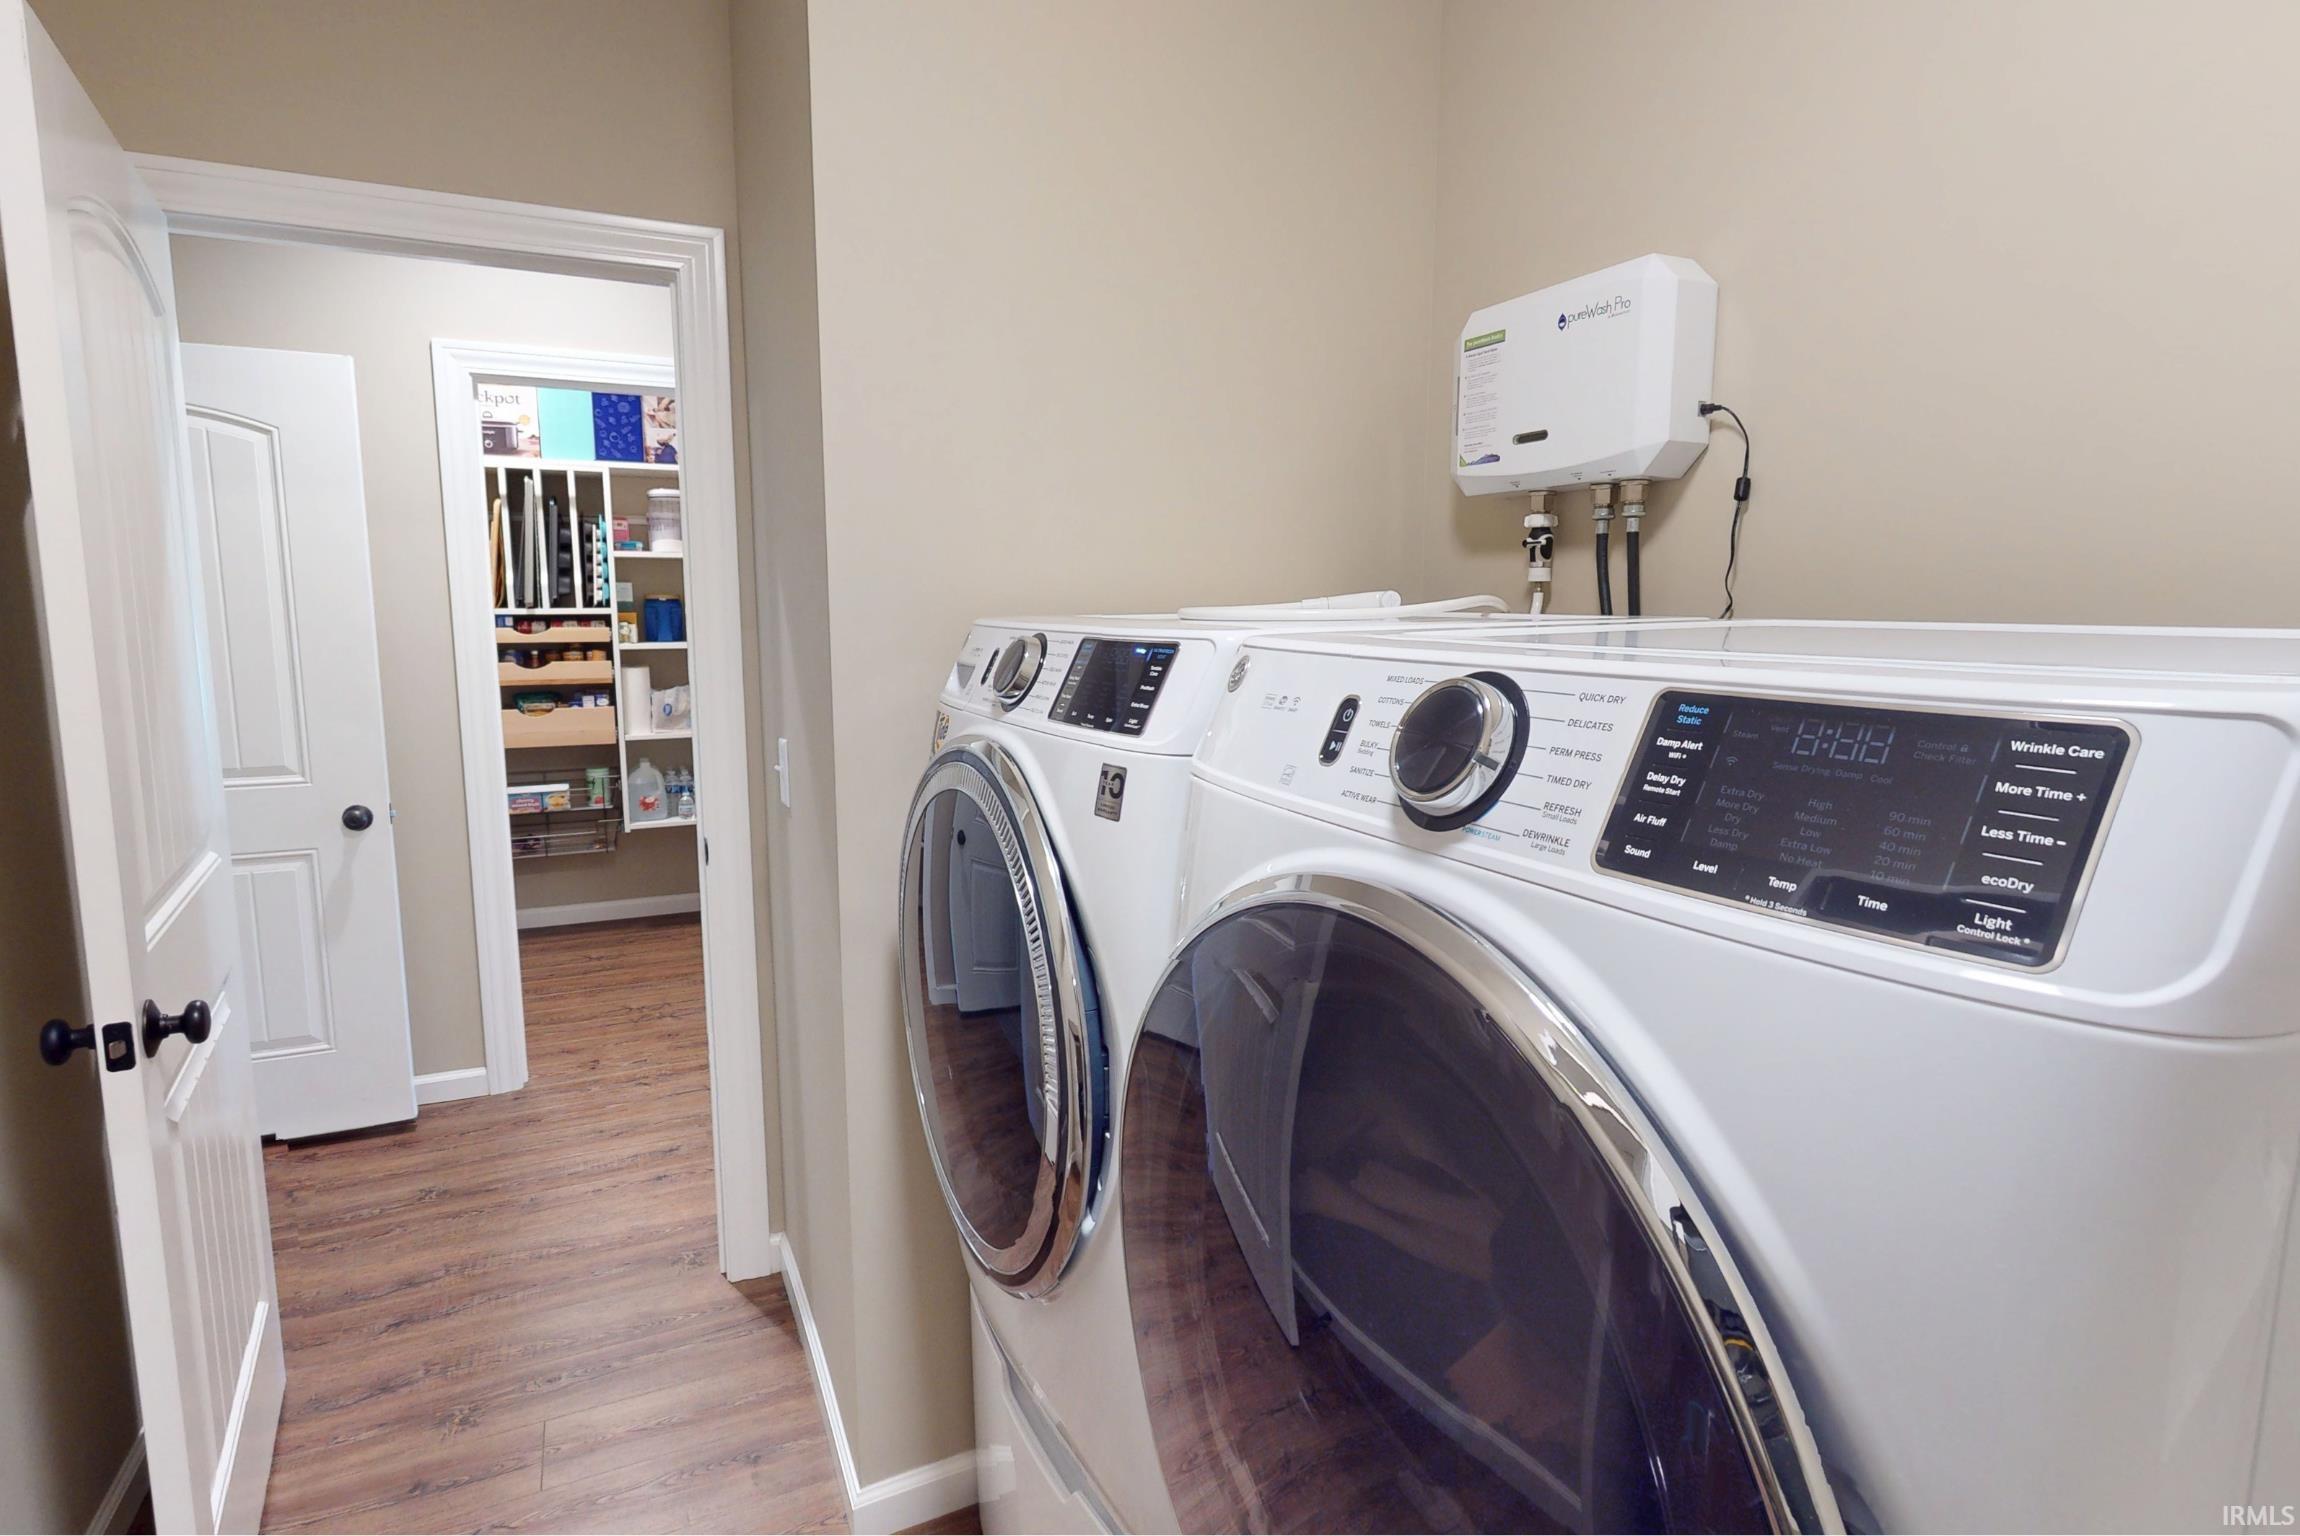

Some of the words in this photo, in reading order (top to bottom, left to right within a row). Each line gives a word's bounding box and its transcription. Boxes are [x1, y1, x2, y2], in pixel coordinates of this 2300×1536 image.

[1567, 300, 1612, 329] pureWash
[1614, 295, 1632, 311] Pro
[1386, 675, 1404, 683] MIXED
[1405, 677, 1424, 685] LOADS
[1377, 696, 1405, 705] COTTONS
[1578, 692, 1607, 702] QUICK
[1606, 695, 1627, 704] DRY
[1678, 703, 1710, 714] Reduce
[1368, 720, 1391, 728] TOWELS
[1567, 718, 1614, 732] DELICATES
[1676, 715, 1703, 725] Static
[1656, 737, 1681, 749] Damp
[1680, 740, 1704, 750] Alert
[2010, 740, 2066, 756] Wrinkle
[2067, 745, 2105, 759] Care
[1549, 746, 1574, 757] PERM
[1574, 750, 1603, 762] PRESS
[1349, 765, 1375, 777] SANITIZE
[1546, 774, 1573, 786] TIMED
[1572, 779, 1593, 790] DRY
[1646, 771, 1671, 784] Delay
[1670, 774, 1687, 787] Dry
[1340, 789, 1361, 801] ACTIVE
[1361, 794, 1377, 804] WEAR
[1642, 784, 1665, 794] Remote
[1665, 787, 1682, 796] Start
[1720, 785, 1745, 796] Extra
[1746, 788, 1765, 801] Dry
[1995, 781, 2033, 796] More
[2035, 786, 2073, 801] Time
[1543, 801, 1583, 817] REFRESH
[1715, 798, 1741, 809] More
[1742, 801, 1760, 815] Dry
[1807, 798, 1833, 812] High
[1542, 810, 1560, 821] Small
[1559, 815, 1578, 825] Loads
[1633, 812, 1647, 824] Air
[1646, 815, 1667, 827] Fluff
[1724, 812, 1742, 825] Dry
[1793, 811, 1838, 826] Medium
[1888, 811, 1906, 823] 90
[1907, 815, 1932, 827] min
[1522, 828, 1571, 848] DEWRINKLE
[1707, 823, 1729, 836] Less
[1731, 827, 1750, 840] Dry
[1800, 826, 1823, 838] Low
[1883, 825, 1901, 837] 60
[1903, 830, 1927, 841] min
[1981, 825, 2014, 840] Less
[2017, 830, 2054, 846] Time
[1530, 841, 1548, 852] Large
[1547, 845, 1566, 856] Loads
[1624, 844, 1651, 859] Sound
[1709, 837, 1739, 851] Damp
[1780, 837, 1808, 850] Extra
[1809, 843, 1833, 855] Low
[1879, 841, 1896, 852] 40
[1897, 845, 1921, 856] min
[1692, 860, 1719, 874] Level
[1779, 852, 1795, 863] No
[1796, 855, 1823, 869] Heat
[1873, 855, 1891, 866] 20
[1892, 860, 1917, 871] min
[1869, 869, 1886, 881] 10
[1768, 875, 1798, 893] Temp
[1981, 874, 2034, 894] ecoDry
[1749, 896, 1768, 907] Hold
[1768, 901, 1775, 909] 3
[1774, 902, 1808, 917] Seconds
[1857, 894, 1888, 911] Time
[1973, 912, 2013, 931] Light
[1956, 924, 1995, 940] Control
[1995, 933, 2022, 946] Lock
